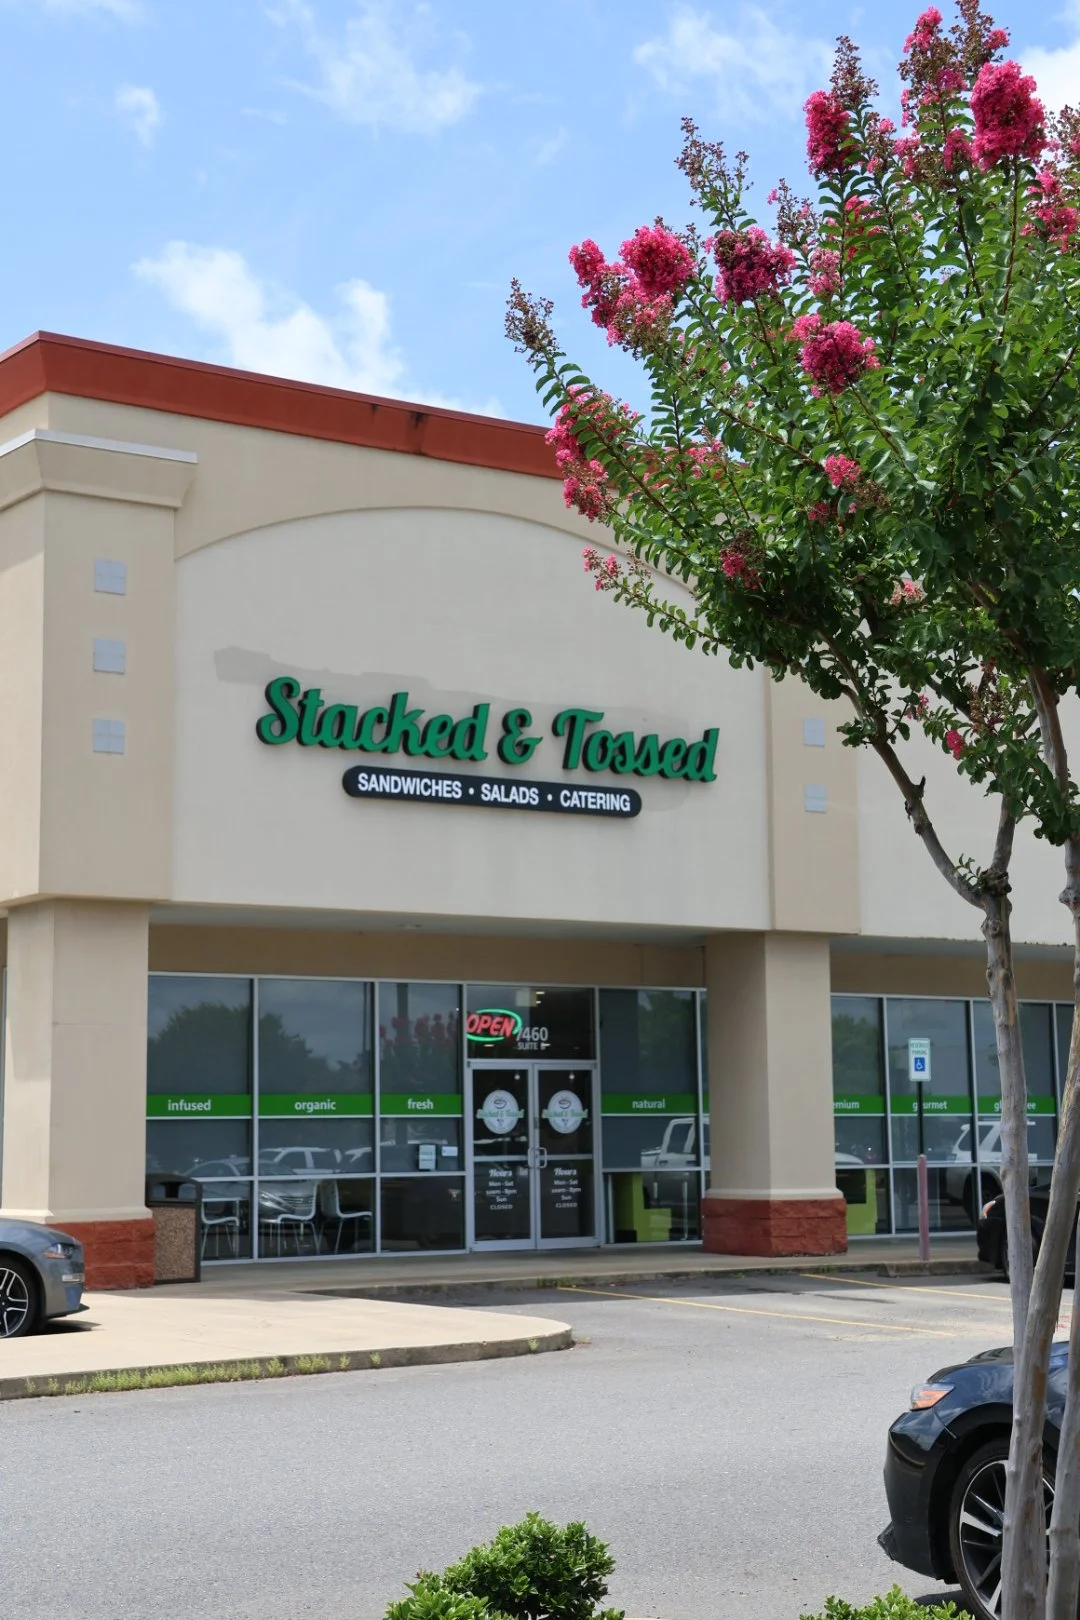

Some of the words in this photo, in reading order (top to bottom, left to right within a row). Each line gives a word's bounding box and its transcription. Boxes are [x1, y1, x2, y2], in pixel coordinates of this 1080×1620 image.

[256, 676, 490, 761] Stacked
[498, 708, 543, 765] &
[552, 708, 720, 782] Tossed
[358, 773, 462, 799] SANDWICHES
[481, 783, 539, 806] SALADS
[560, 789, 631, 812] CATERING
[466, 1013, 515, 1037] OPEN
[517, 1042, 539, 1050] SUITE
[167, 1099, 212, 1111] infused
[294, 1099, 336, 1113] organic
[407, 1098, 434, 1110] fresh
[632, 1099, 665, 1109] natural
[832, 1100, 860, 1109] emium
[912, 1101, 947, 1112] gurmet
